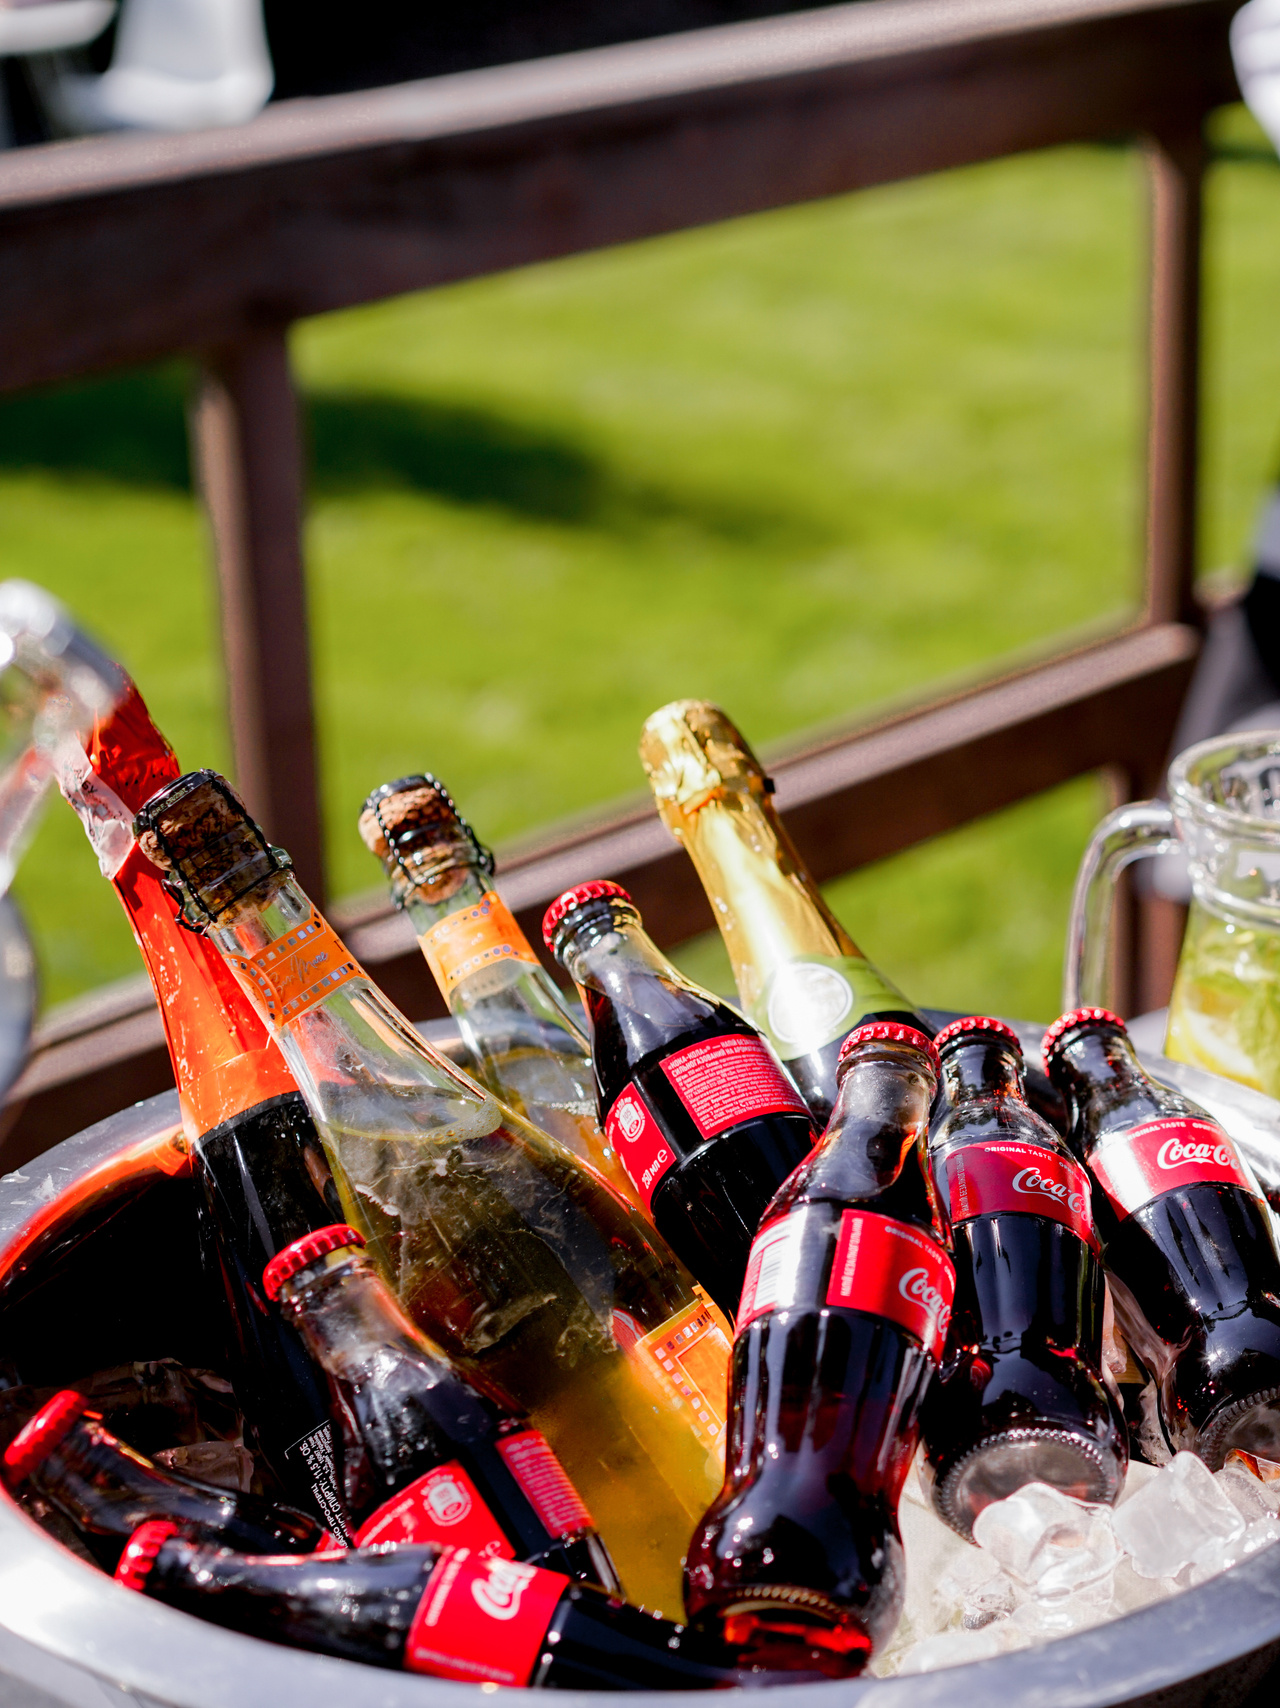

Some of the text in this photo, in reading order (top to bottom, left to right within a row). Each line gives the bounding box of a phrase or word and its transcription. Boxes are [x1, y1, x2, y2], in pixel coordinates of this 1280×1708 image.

[1160, 1122, 1186, 1130] TASTE
[1028, 1150, 1052, 1161] TASTE
[300, 1440, 311, 1457] ОБ.
[310, 1462, 324, 1480] 11,5
[318, 1477, 341, 1513] СПИРТУ:
